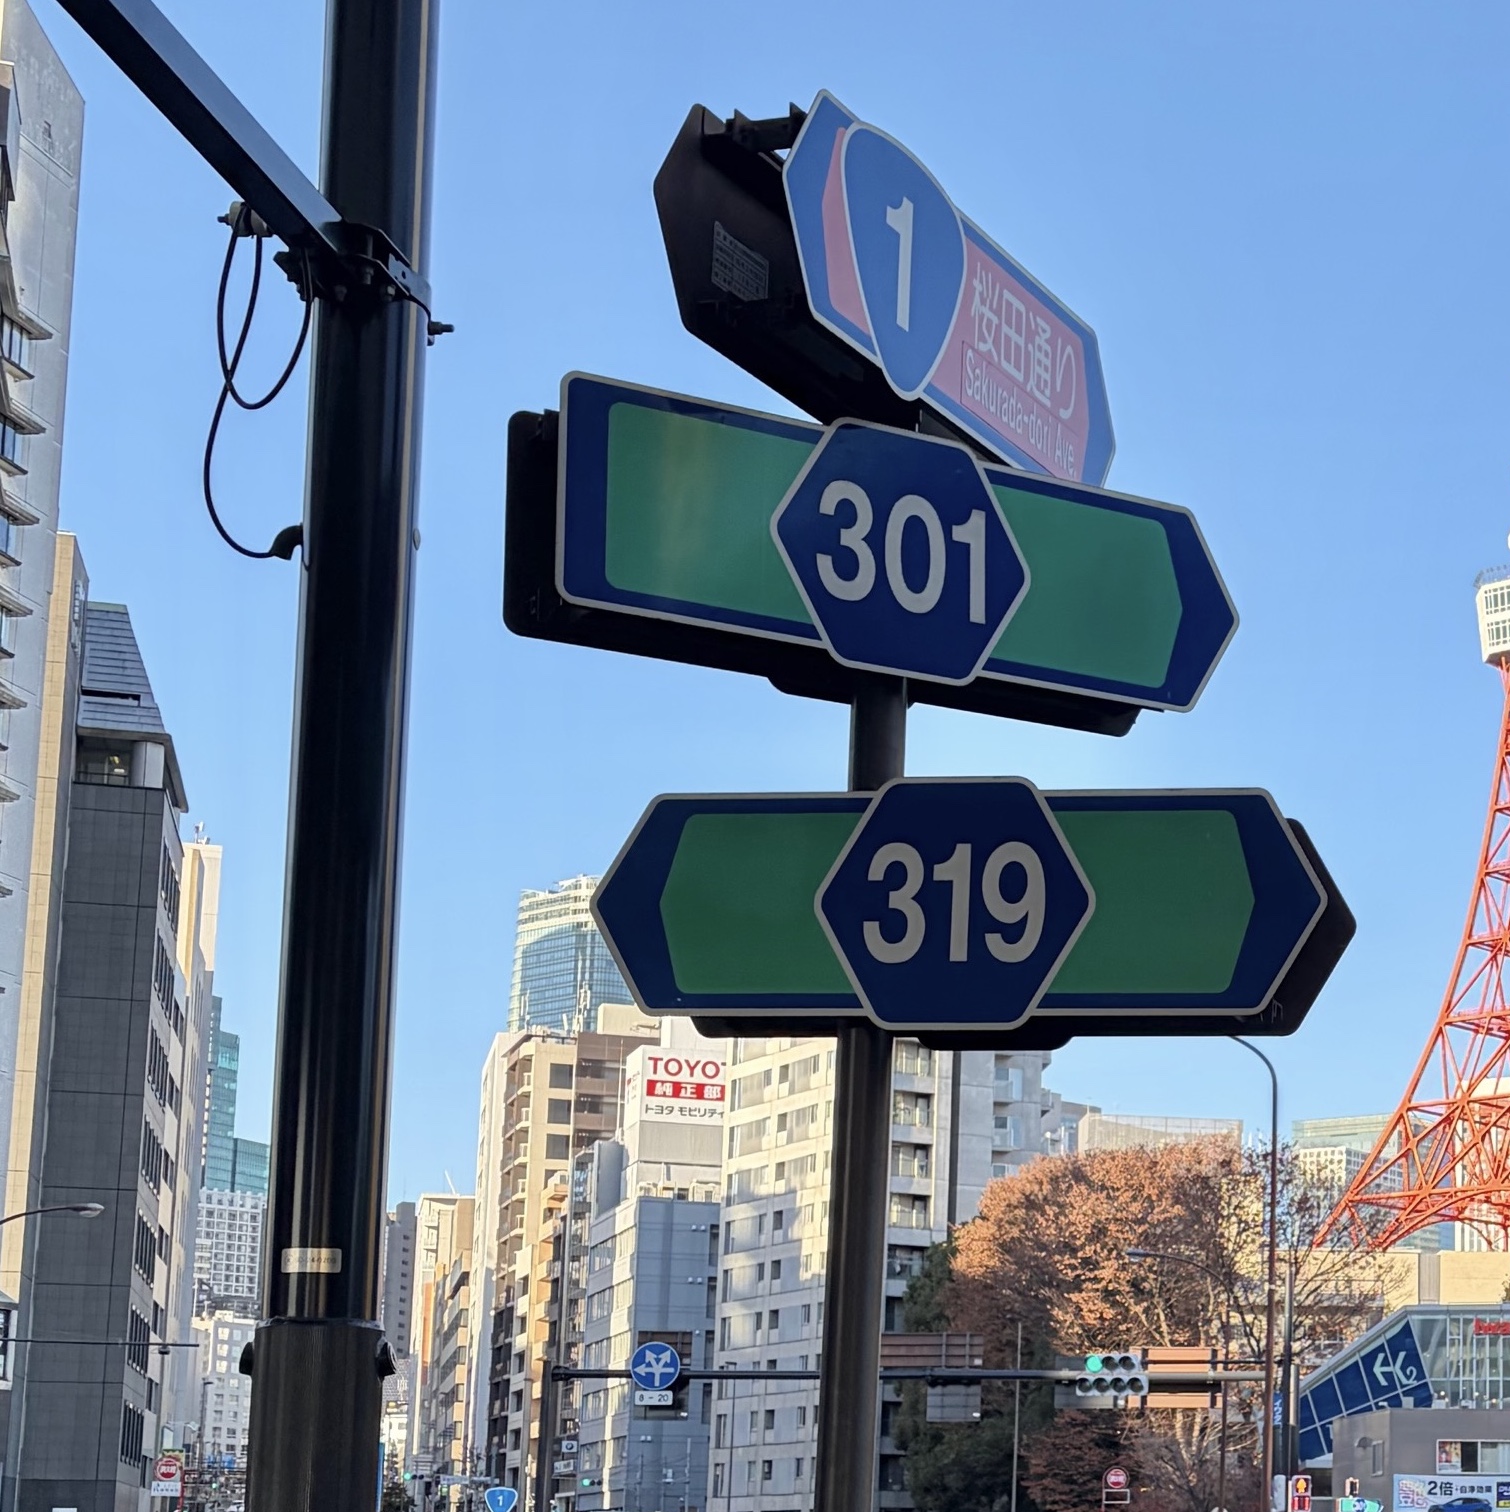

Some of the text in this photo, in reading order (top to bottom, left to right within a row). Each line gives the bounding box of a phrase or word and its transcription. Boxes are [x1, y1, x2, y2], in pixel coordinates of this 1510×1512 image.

[886, 196, 914, 332] 1
[971, 261, 1076, 420] 桜田通り
[965, 348, 1077, 479] Sakurada-dori Ave.
[816, 480, 988, 625] 301
[862, 841, 1046, 963] 319
[645, 1104, 675, 1116] トヨタ
[647, 1056, 726, 1079] TOYO
[497, 1495, 504, 1507] 1
